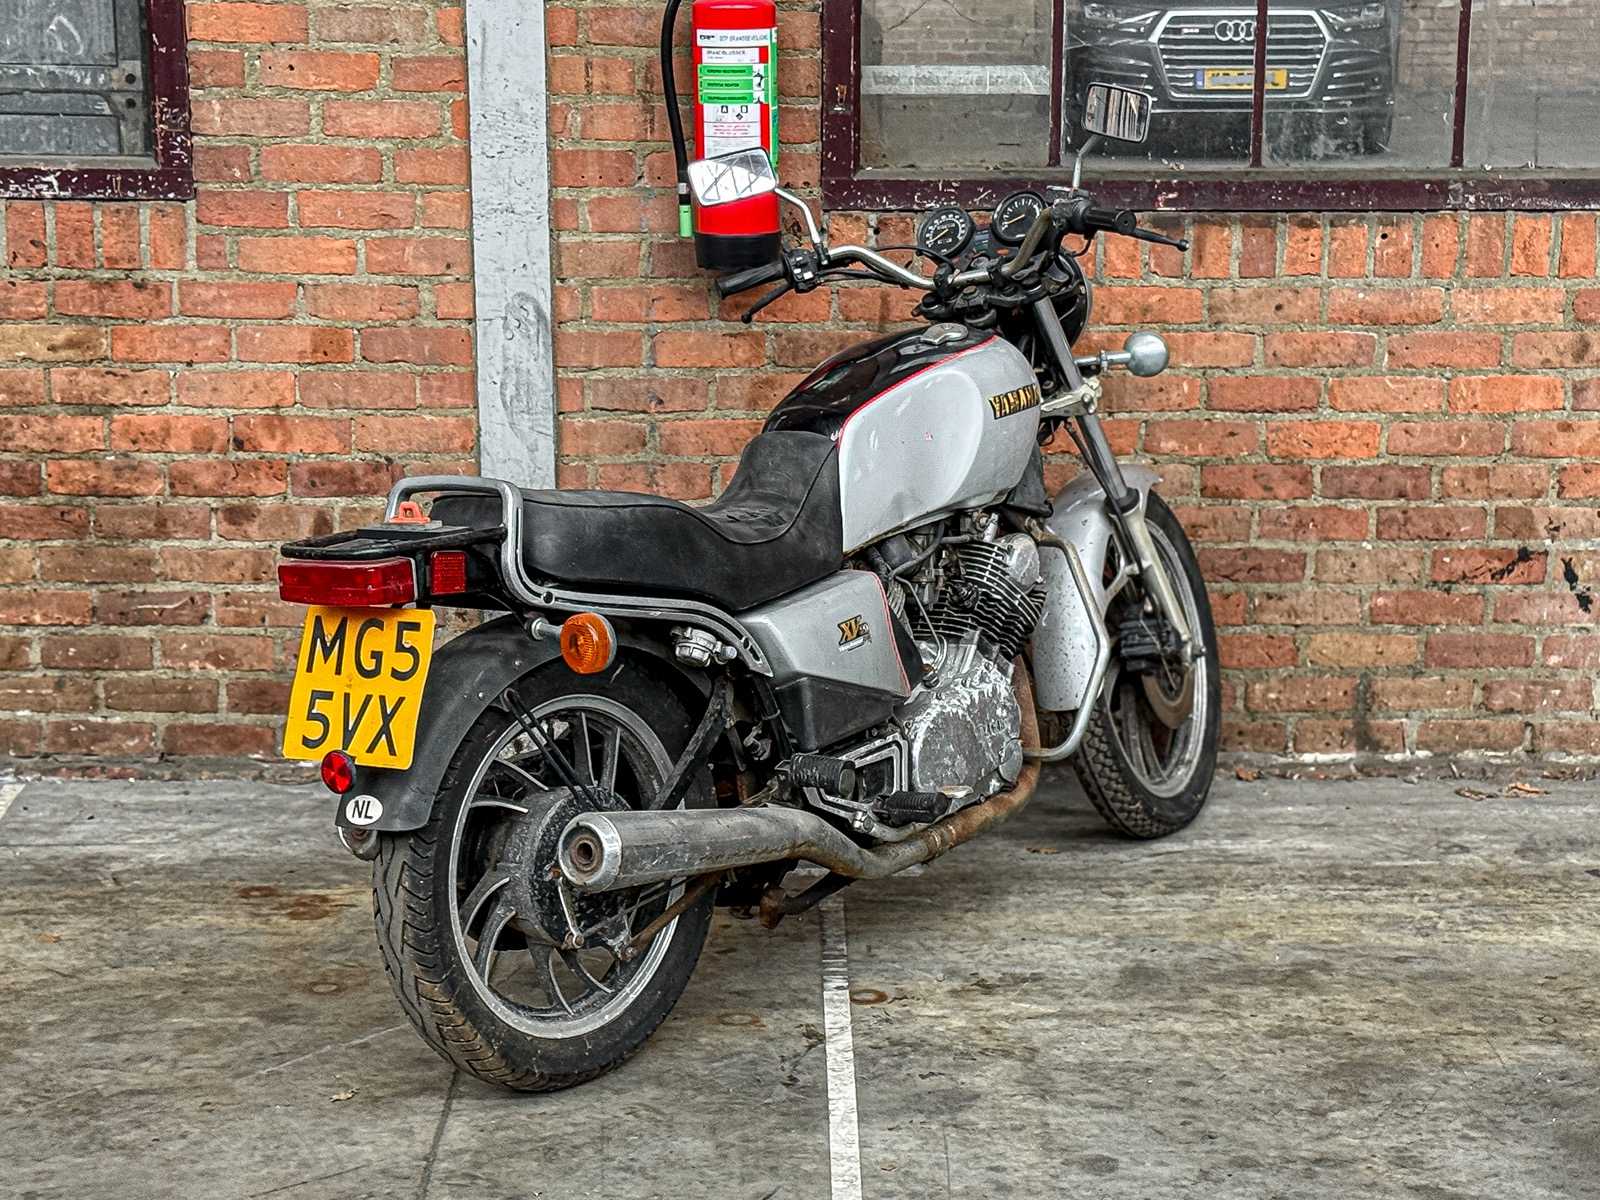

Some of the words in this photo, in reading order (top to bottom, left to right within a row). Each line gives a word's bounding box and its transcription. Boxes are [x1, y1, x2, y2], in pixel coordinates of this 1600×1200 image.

[306, 615, 421, 682] MG5
[302, 690, 406, 756] 5VX
[352, 801, 373, 819] NL
